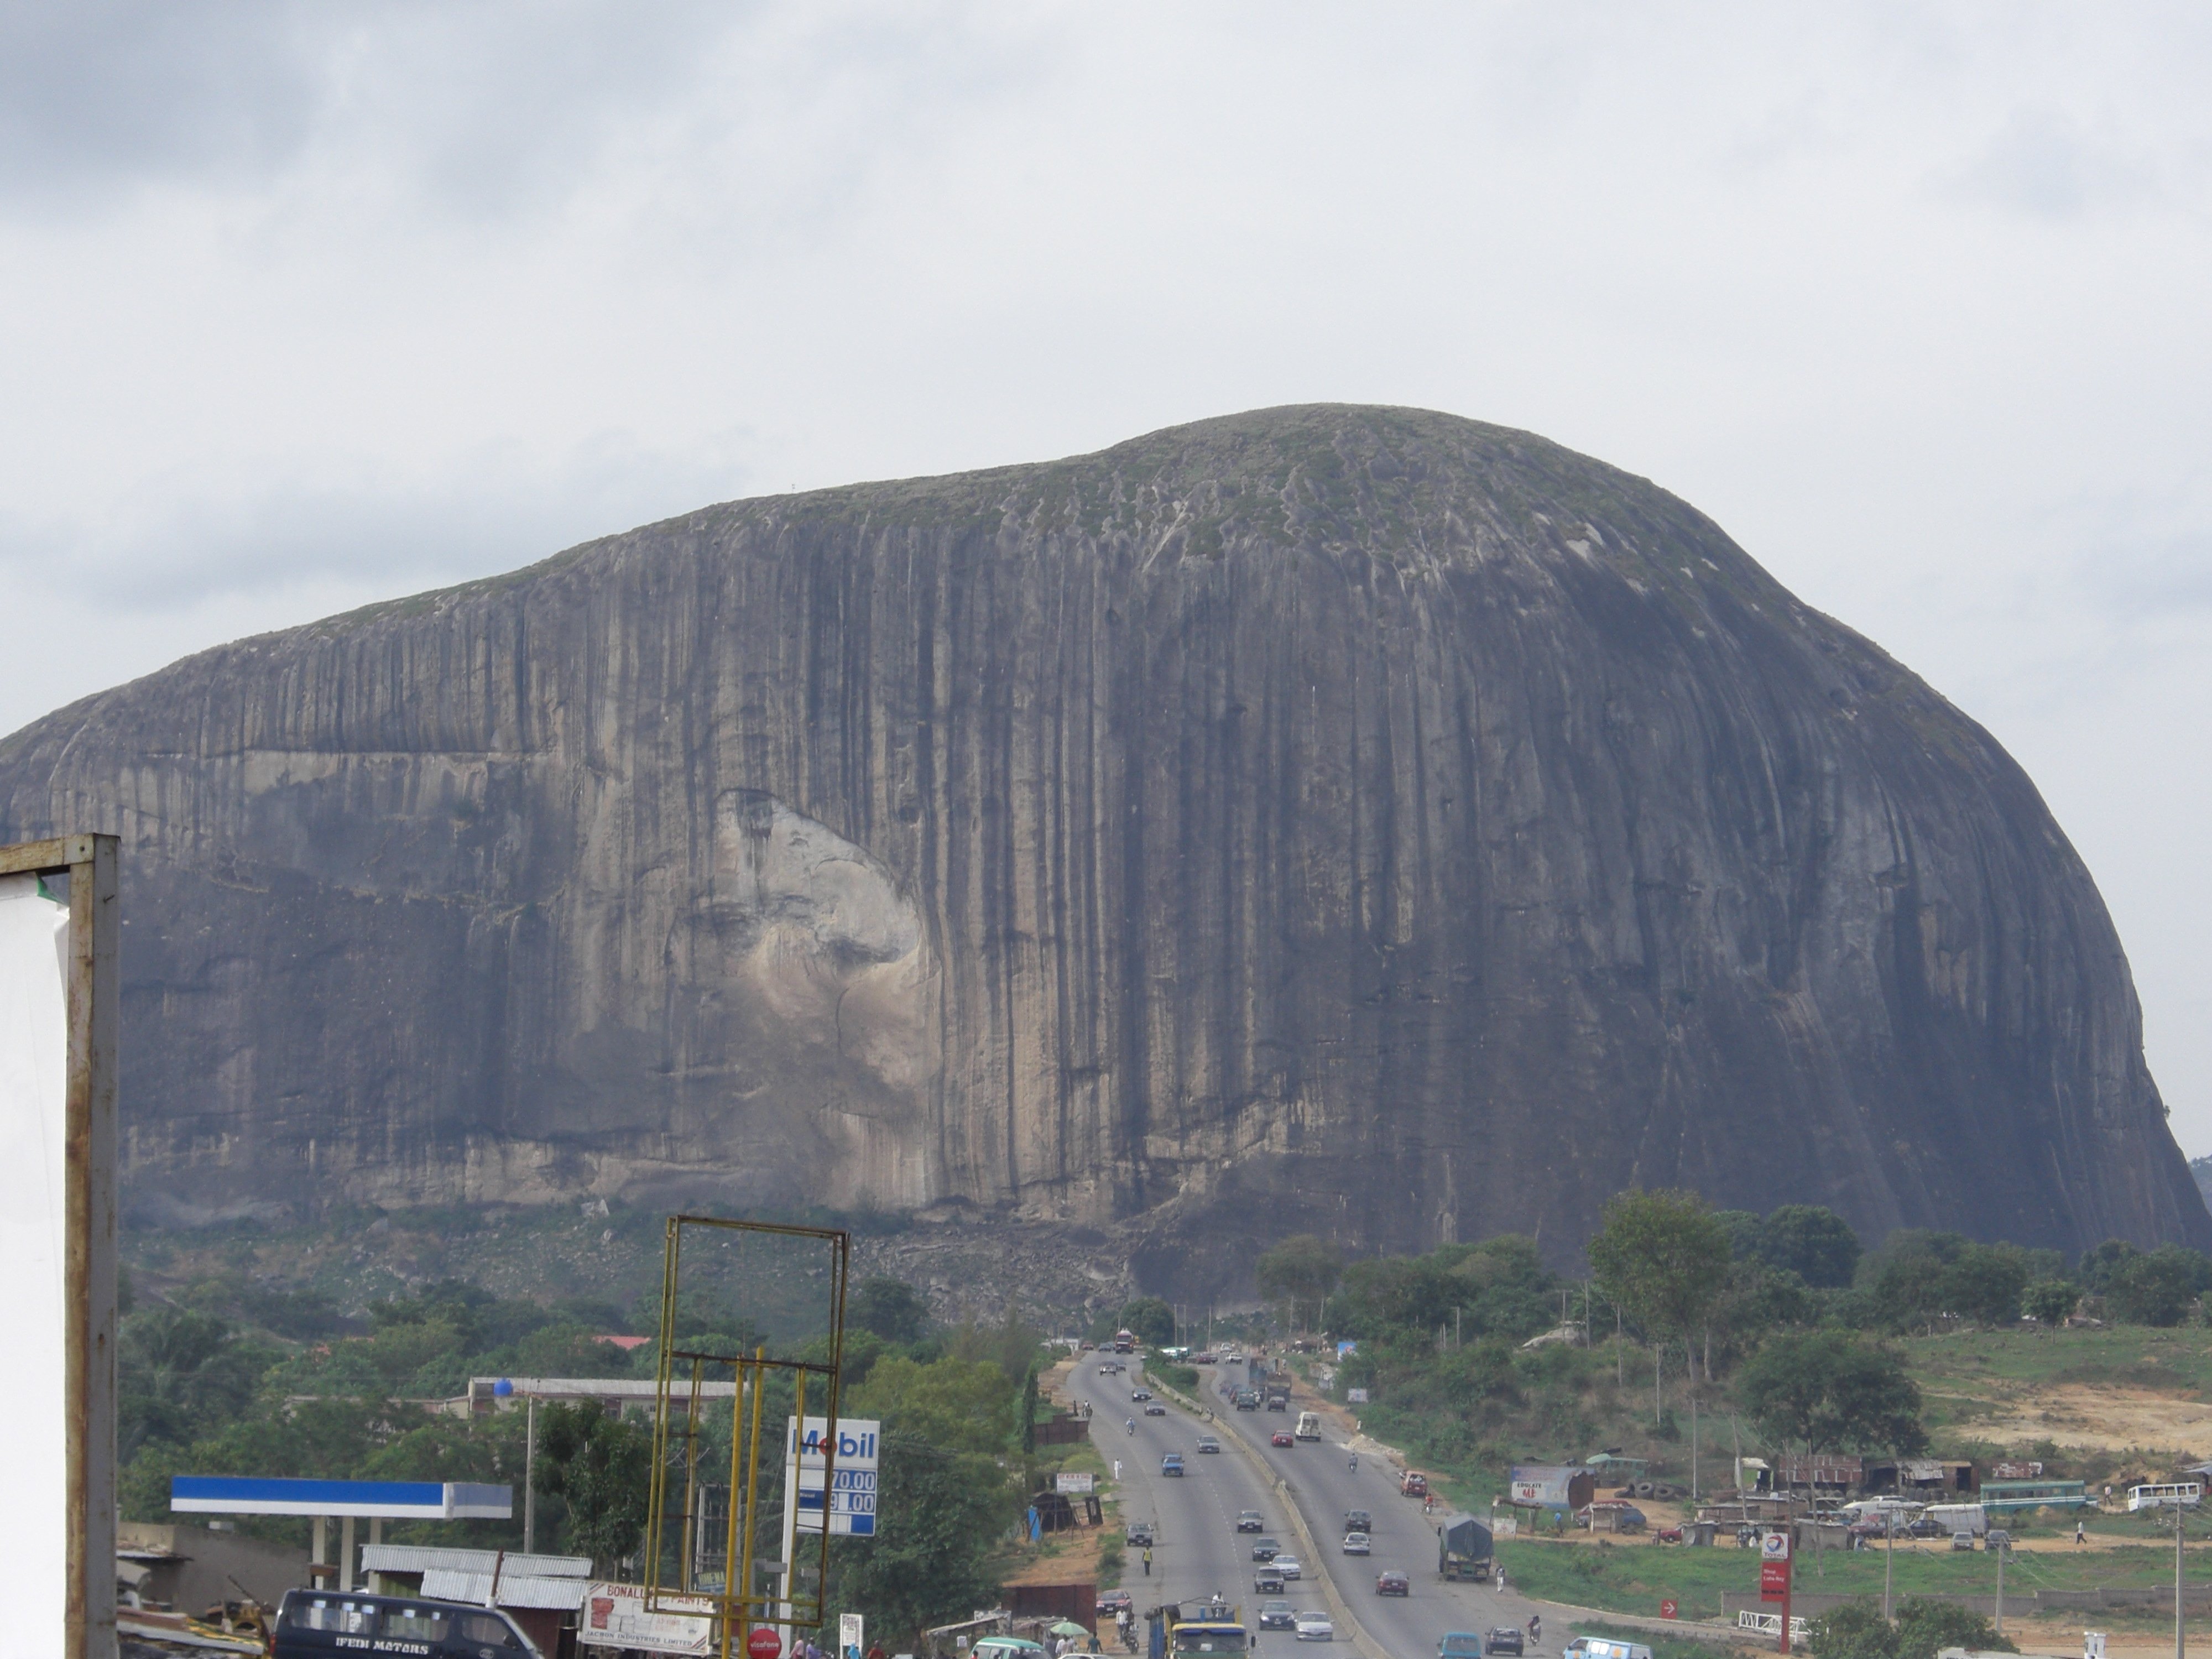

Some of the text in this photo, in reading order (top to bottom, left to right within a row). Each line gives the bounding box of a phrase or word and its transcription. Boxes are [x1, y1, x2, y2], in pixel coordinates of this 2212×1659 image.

[792, 1429, 874, 1458] Mobil
[336, 1637, 429, 1655] IFEDI MOTORS
